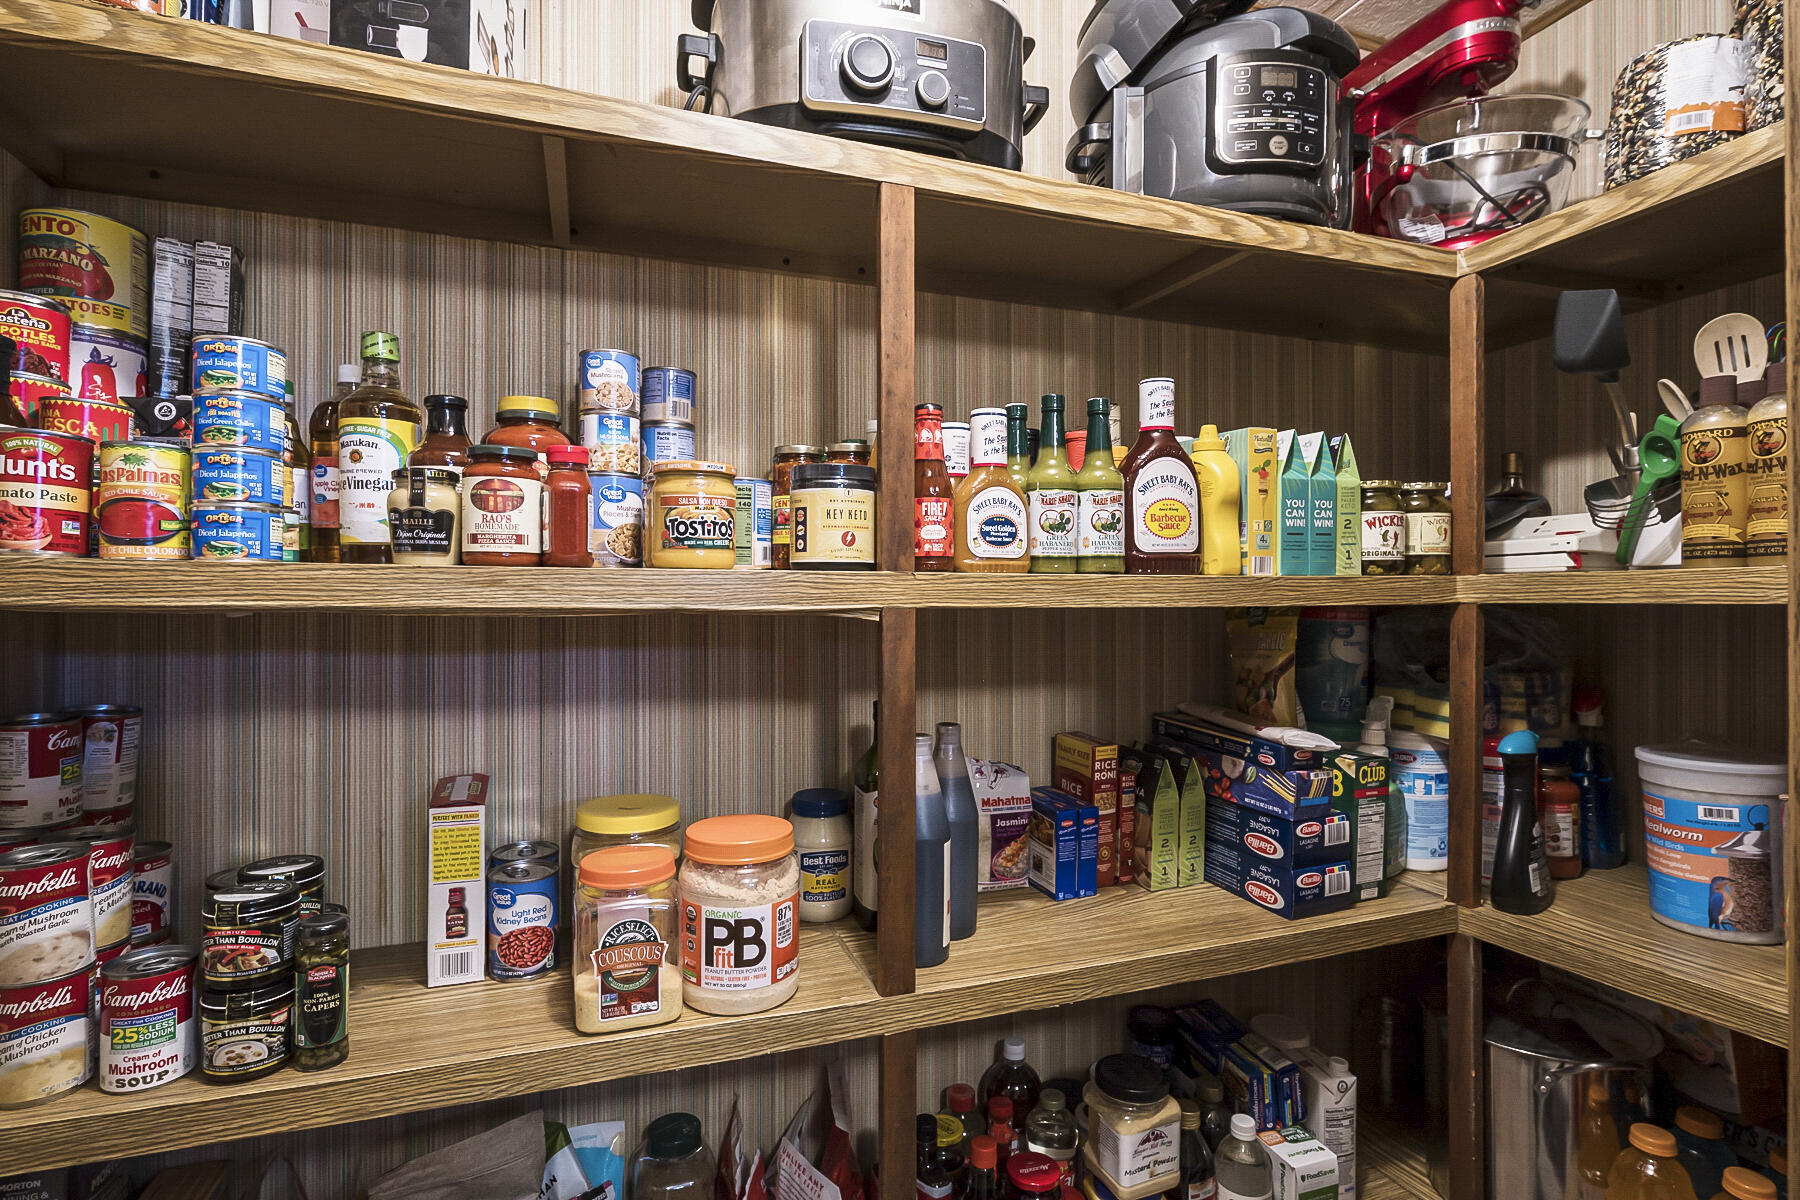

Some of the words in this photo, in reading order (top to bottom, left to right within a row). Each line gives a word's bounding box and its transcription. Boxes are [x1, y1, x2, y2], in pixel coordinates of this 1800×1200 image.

[23, 247, 94, 272] MARZANO
[11, 309, 25, 317] La
[41, 340, 62, 351] SAUCE
[203, 342, 239, 354] ORTEGA
[197, 359, 213, 367] Diced
[205, 397, 243, 409] ORTEGA
[1150, 402, 1160, 410] The
[1156, 409, 1166, 419] the
[23, 439, 59, 453] NATURAL
[340, 438, 379, 449] Marukan
[984, 437, 995, 445] The
[990, 447, 1001, 456] the
[206, 453, 246, 466] ORTEGA
[199, 470, 218, 478] Diced
[220, 470, 258, 480] Jalapeños
[1138, 476, 1161, 496] SWEET
[1160, 474, 1178, 485] BABY
[1178, 478, 1194, 496] RAY'S
[39, 489, 78, 503] Paste
[116, 487, 141, 495] CHILE
[142, 488, 170, 501] SAUCE
[602, 488, 623, 497] Great
[678, 497, 698, 506] SALSA
[973, 499, 992, 515] SWEET
[992, 497, 1008, 507] BABY
[1008, 500, 1023, 516] RAY'S
[1285, 500, 1305, 508] YOU
[1314, 500, 1333, 508] YOU
[826, 508, 844, 520] KEY
[848, 509, 868, 521] KETO
[921, 501, 947, 516] FIRE!
[1285, 509, 1305, 518] CAN
[1314, 509, 1333, 518] CAN
[205, 511, 244, 524] ORTEGA
[402, 518, 434, 526] MAILLE
[481, 513, 512, 524] RAO'S
[1150, 514, 1187, 523] Barbecue
[1285, 519, 1306, 527] WIN!
[1314, 519, 1334, 527] WIN!
[474, 522, 520, 531] HOMEMADE
[668, 515, 734, 538] TOSTITOS
[981, 524, 998, 533] Sweet
[998, 524, 1016, 533] Golden
[1158, 522, 1181, 532] Sauce
[1343, 519, 1352, 530] 2
[198, 528, 217, 537] Diced
[218, 529, 256, 539] Jalapeños
[118, 546, 141, 555] CHILE
[144, 546, 189, 556] COLORADO
[1345, 550, 1352, 560] 1
[1362, 550, 1396, 558] ORIGINAL
[1094, 760, 1117, 770] RICE
[63, 763, 81, 780] 25
[1094, 770, 1117, 781] RONI
[1359, 767, 1386, 785] CLUB
[1061, 779, 1082, 796] RICE
[981, 795, 1032, 809] Mahatma
[1250, 819, 1280, 838] LASAGNE
[1302, 823, 1322, 835] Barilla
[1162, 838, 1170, 849] 2
[1189, 835, 1197, 845] 2
[1247, 836, 1275, 855] Barilla
[803, 856, 824, 866] Best
[824, 854, 847, 865] Foods
[1162, 866, 1168, 877] 1
[1250, 867, 1280, 888] LASAGNE
[815, 878, 837, 886] REAL
[492, 891, 512, 902] Great
[805, 894, 824, 902] 100%
[1248, 884, 1275, 904] Barilla
[30, 897, 75, 916] COOKING
[511, 909, 531, 919] Light
[532, 904, 548, 915] Red
[28, 908, 80, 928] Mushroom
[496, 916, 522, 926] Kidney
[523, 913, 548, 924] Beans
[704, 909, 743, 919] ORGANIC
[15, 926, 47, 941] Roasted
[48, 917, 71, 930] Garlic
[215, 936, 236, 944] THAN
[238, 936, 281, 947] BOUILLON
[704, 917, 768, 969] PB
[598, 945, 662, 968] COUSCOUS
[714, 947, 735, 969] fit
[616, 961, 644, 969] ORIGINAL
[704, 967, 724, 975] PEANUT
[724, 967, 745, 975] BUTTER
[745, 966, 768, 974] POWDER
[104, 974, 188, 1011] Campbell's
[304, 999, 340, 1013] CAPERS
[145, 1011, 175, 1023] COOKING
[20, 1017, 66, 1036] COOKING
[149, 1019, 175, 1033] LESS
[224, 1028, 247, 1037] THAN
[249, 1025, 286, 1034] BOUILLON
[25, 1026, 67, 1045] Chicken
[139, 1026, 175, 1042] SODIUM
[4, 1037, 60, 1064] Mushroom
[123, 1053, 150, 1063] Cream
[152, 1049, 161, 1059] of
[109, 1053, 179, 1076] Mushroom
[115, 1069, 170, 1089] SOUP
[1124, 1161, 1152, 1177] Mustard
[1153, 1155, 1179, 1168] Powder
[1306, 1168, 1336, 1181] FoodSaver
